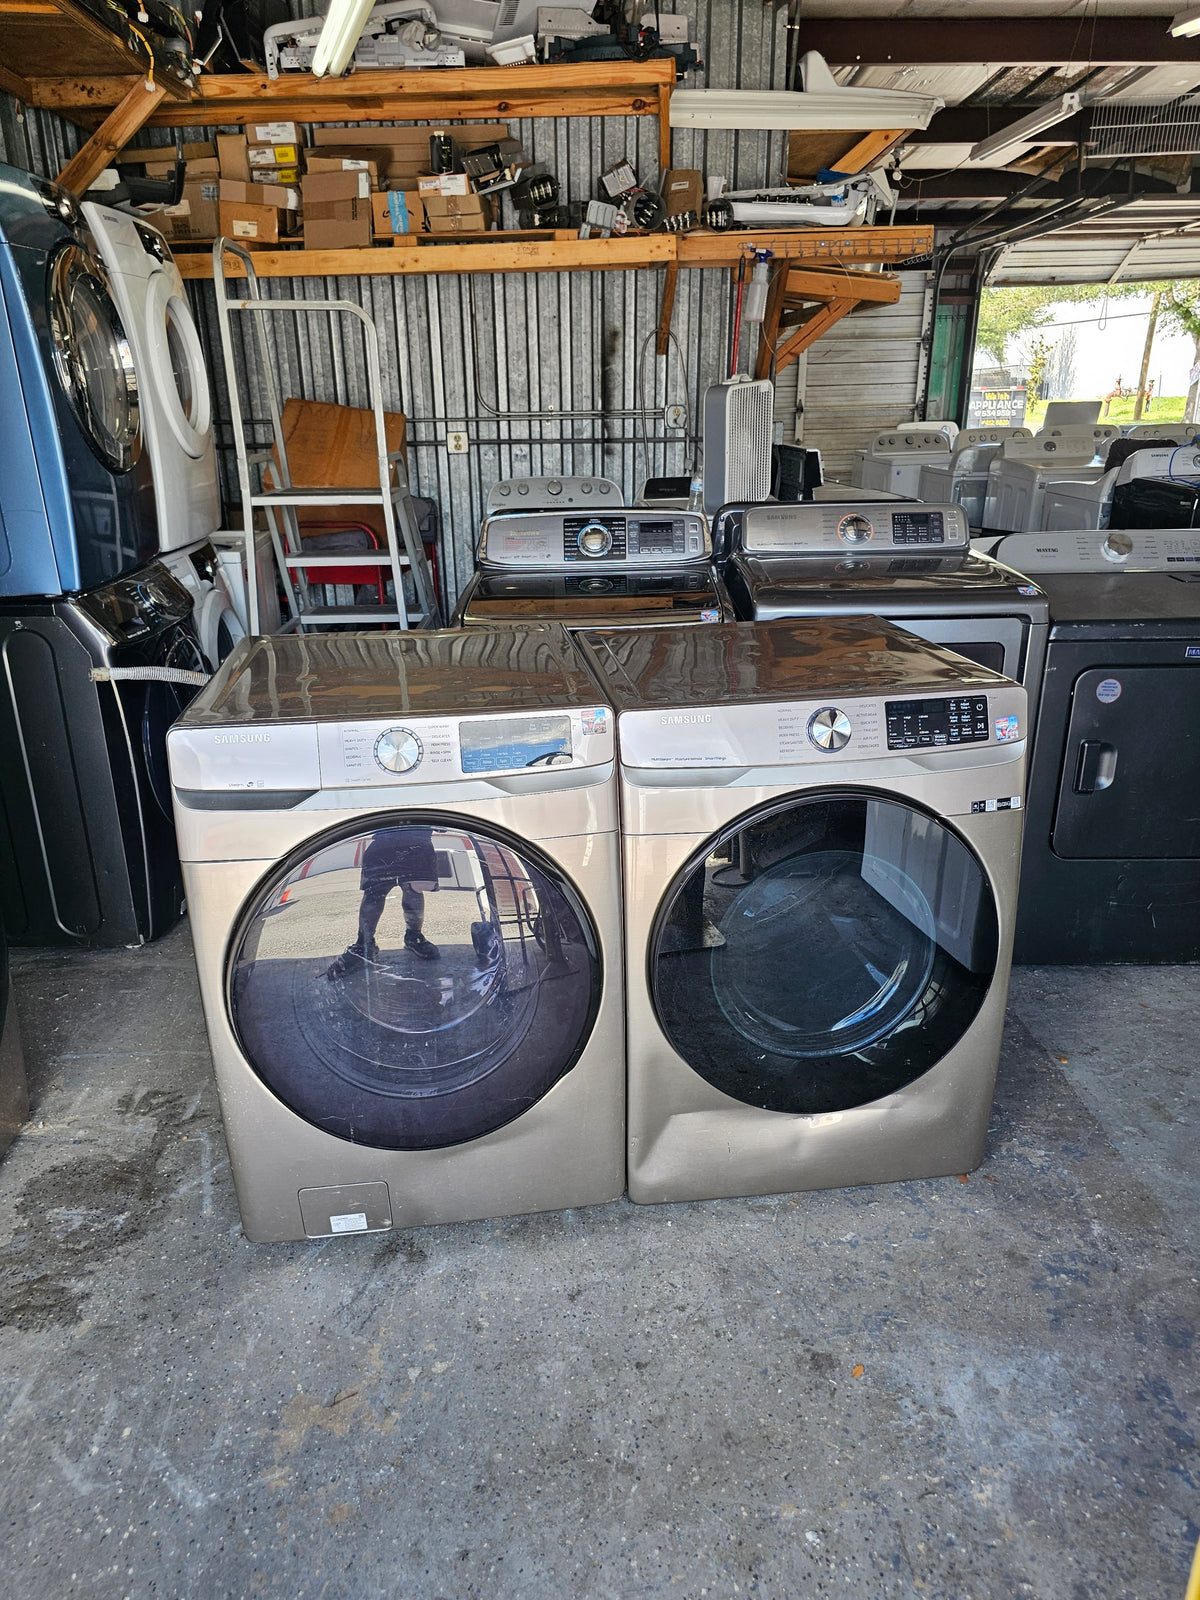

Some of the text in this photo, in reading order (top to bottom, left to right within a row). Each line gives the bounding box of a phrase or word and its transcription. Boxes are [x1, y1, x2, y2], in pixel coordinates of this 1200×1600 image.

[969, 400, 1024, 410] APPLIANCE
[661, 714, 712, 725] SAMSUNG
[214, 733, 271, 744] SAMSUNG
